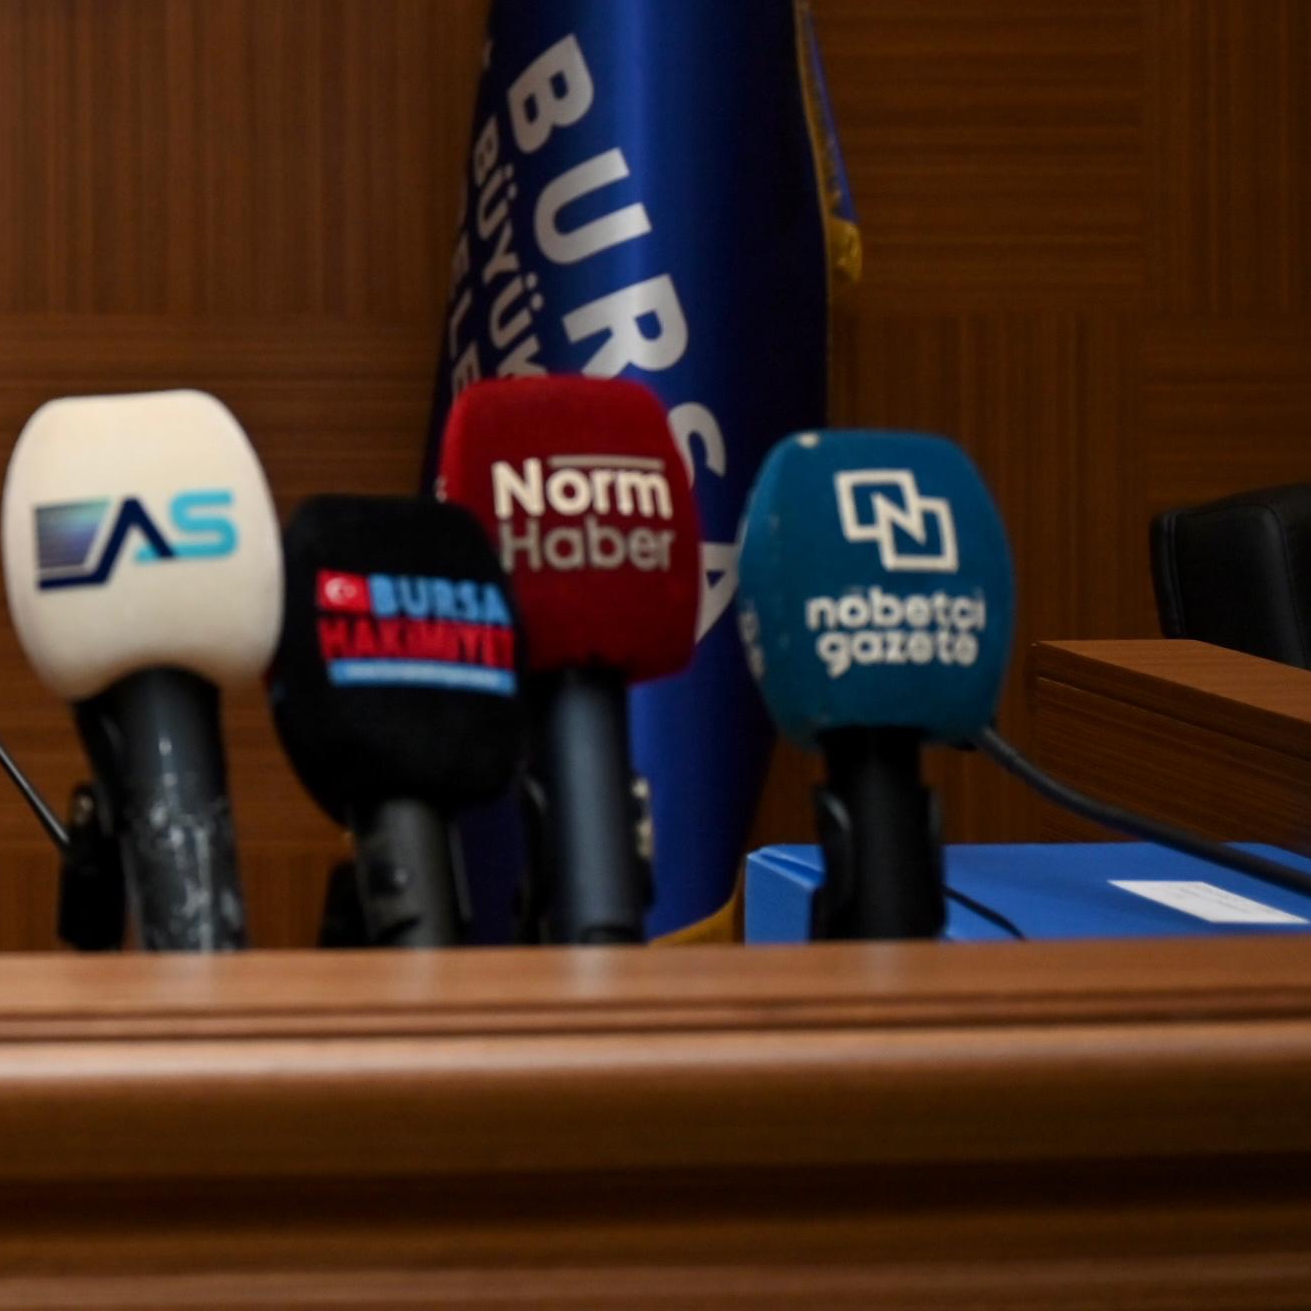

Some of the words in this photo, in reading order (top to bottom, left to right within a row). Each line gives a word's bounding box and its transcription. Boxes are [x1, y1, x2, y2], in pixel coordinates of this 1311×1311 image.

[491, 458, 673, 520] Norm
[499, 516, 675, 573] Haber
[369, 573, 514, 627] BURSA
[816, 630, 978, 679] gazete
